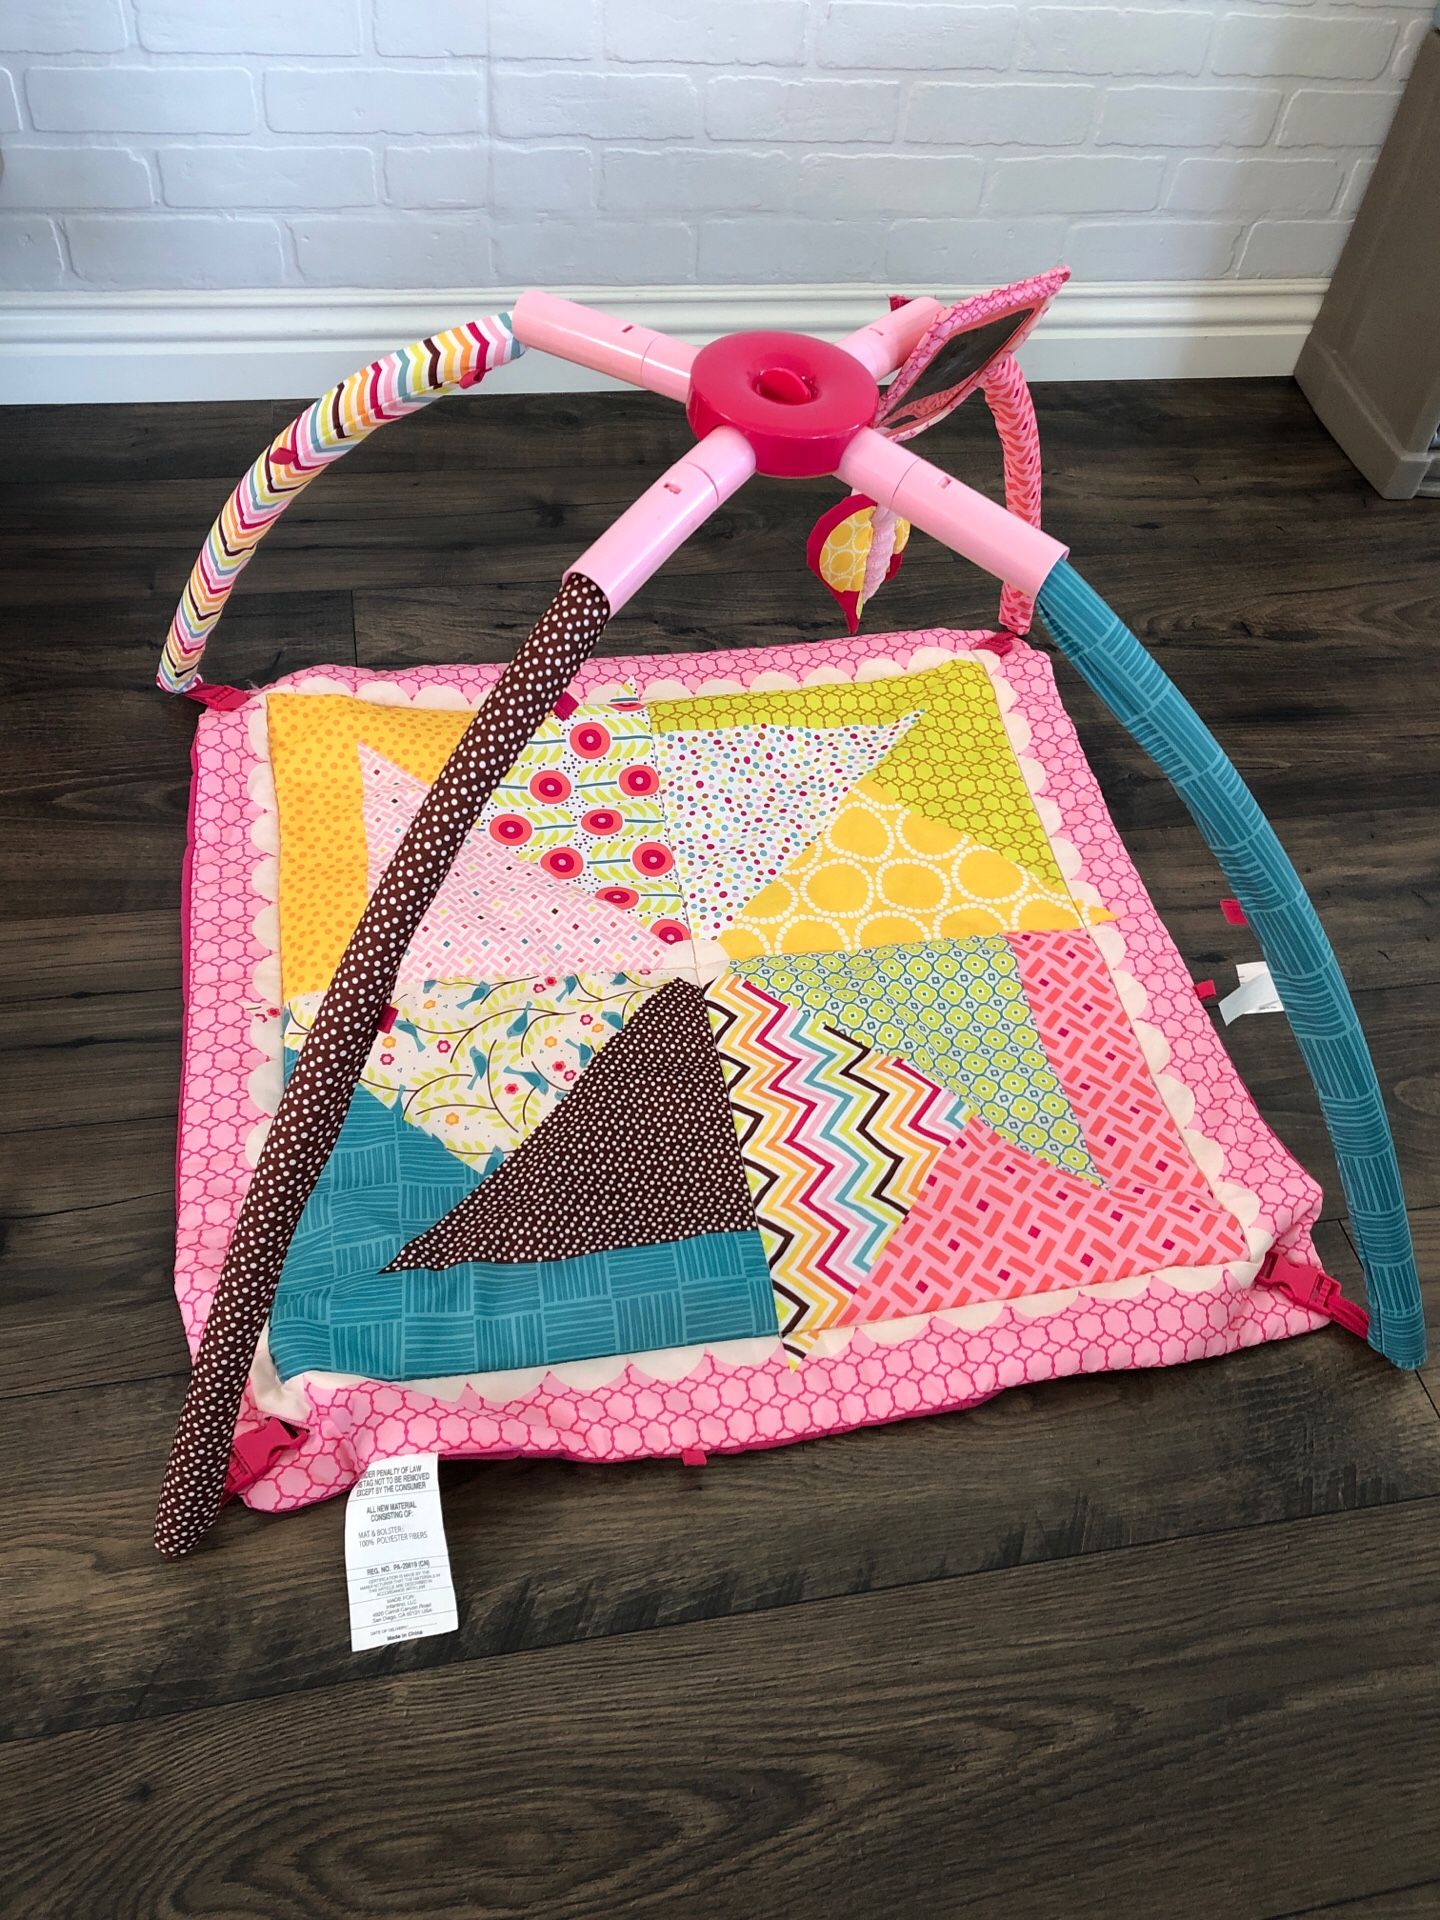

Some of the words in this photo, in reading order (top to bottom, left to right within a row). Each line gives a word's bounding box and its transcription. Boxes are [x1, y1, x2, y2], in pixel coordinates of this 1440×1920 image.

[377, 1468, 400, 1476] PENALTY
[403, 1472, 430, 1482] REMOVED
[356, 1488, 374, 1497] EXCEPT
[376, 1486, 382, 1494] BY
[384, 1485, 394, 1493] THE
[395, 1482, 426, 1492] CONSUMER
[390, 1501, 417, 1510] MATERIAL
[370, 1511, 403, 1522] CONSISTING
[360, 1540, 374, 1548] 100%
[376, 1534, 408, 1544] POLYESTER
